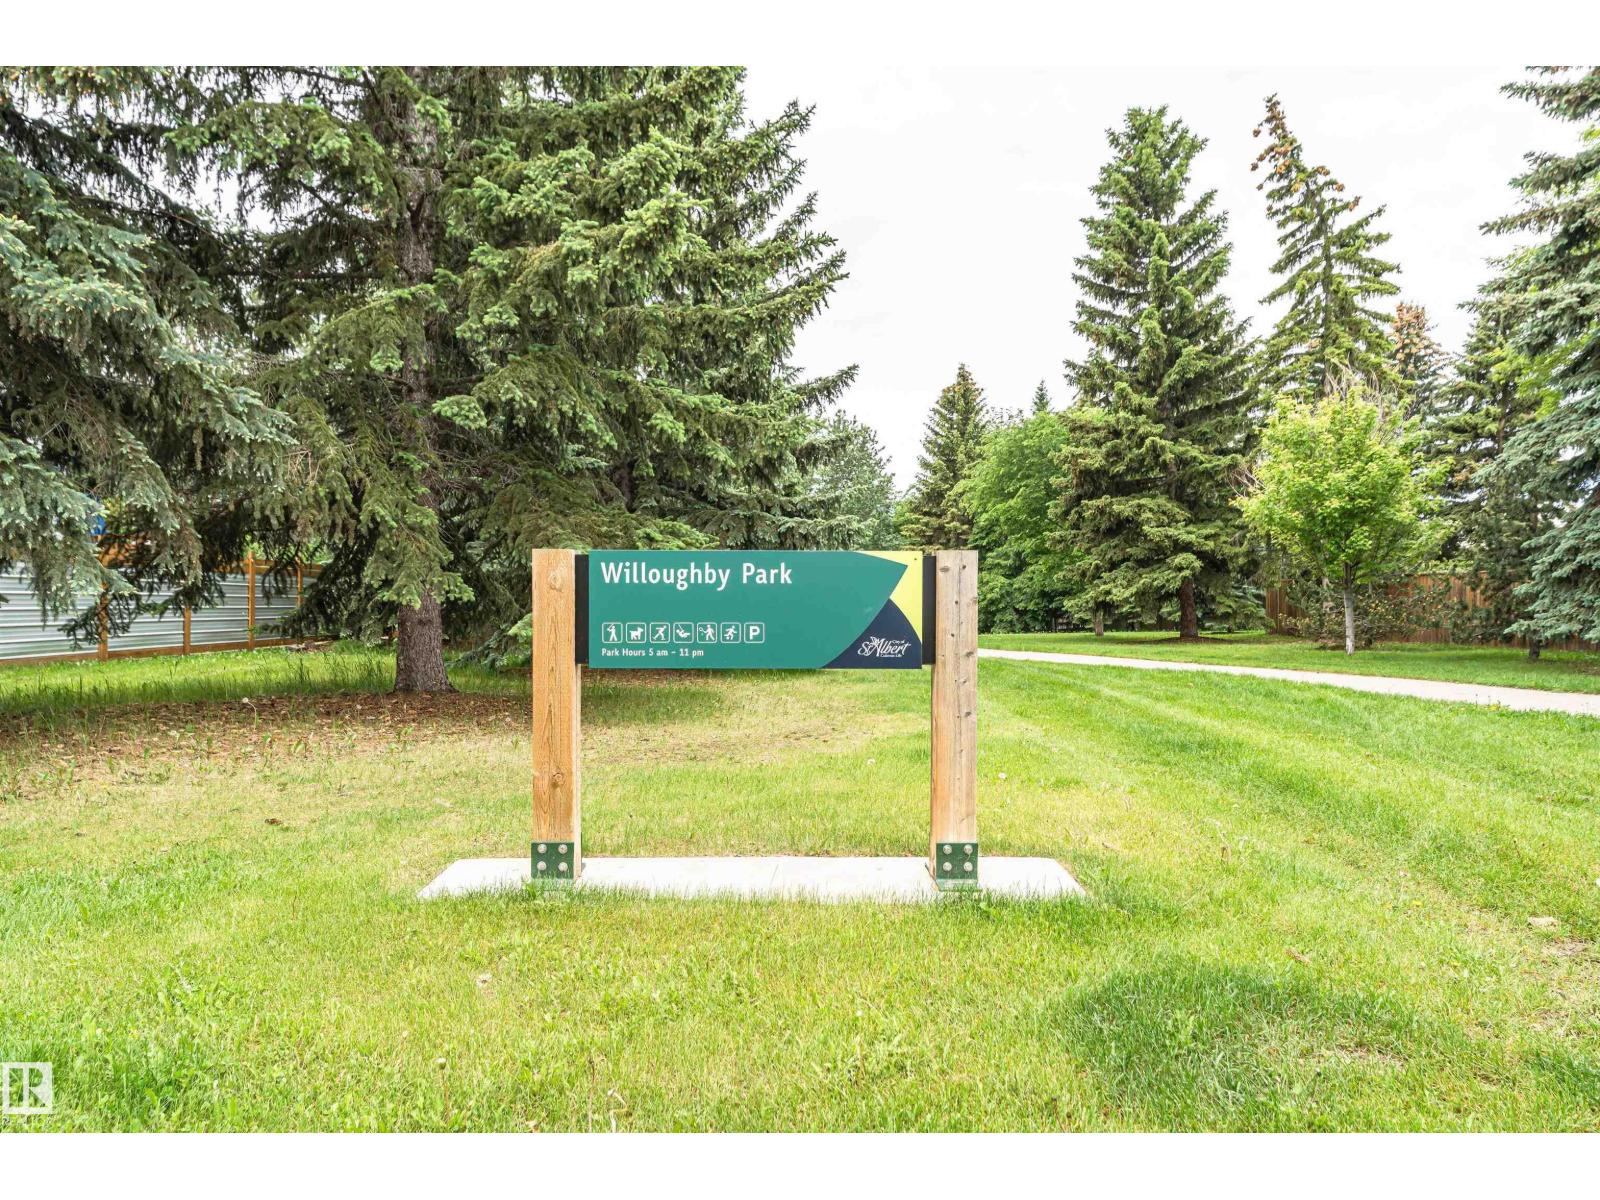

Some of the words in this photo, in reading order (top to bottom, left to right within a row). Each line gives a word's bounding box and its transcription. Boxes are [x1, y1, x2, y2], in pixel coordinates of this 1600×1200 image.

[600, 561, 730, 591] Willoughby
[742, 562, 792, 584] Park
[601, 648, 620, 656] Park
[622, 648, 645, 656] Hours
[648, 648, 654, 656] 5
[679, 648, 689, 656] 11
[692, 649, 704, 658] pm
